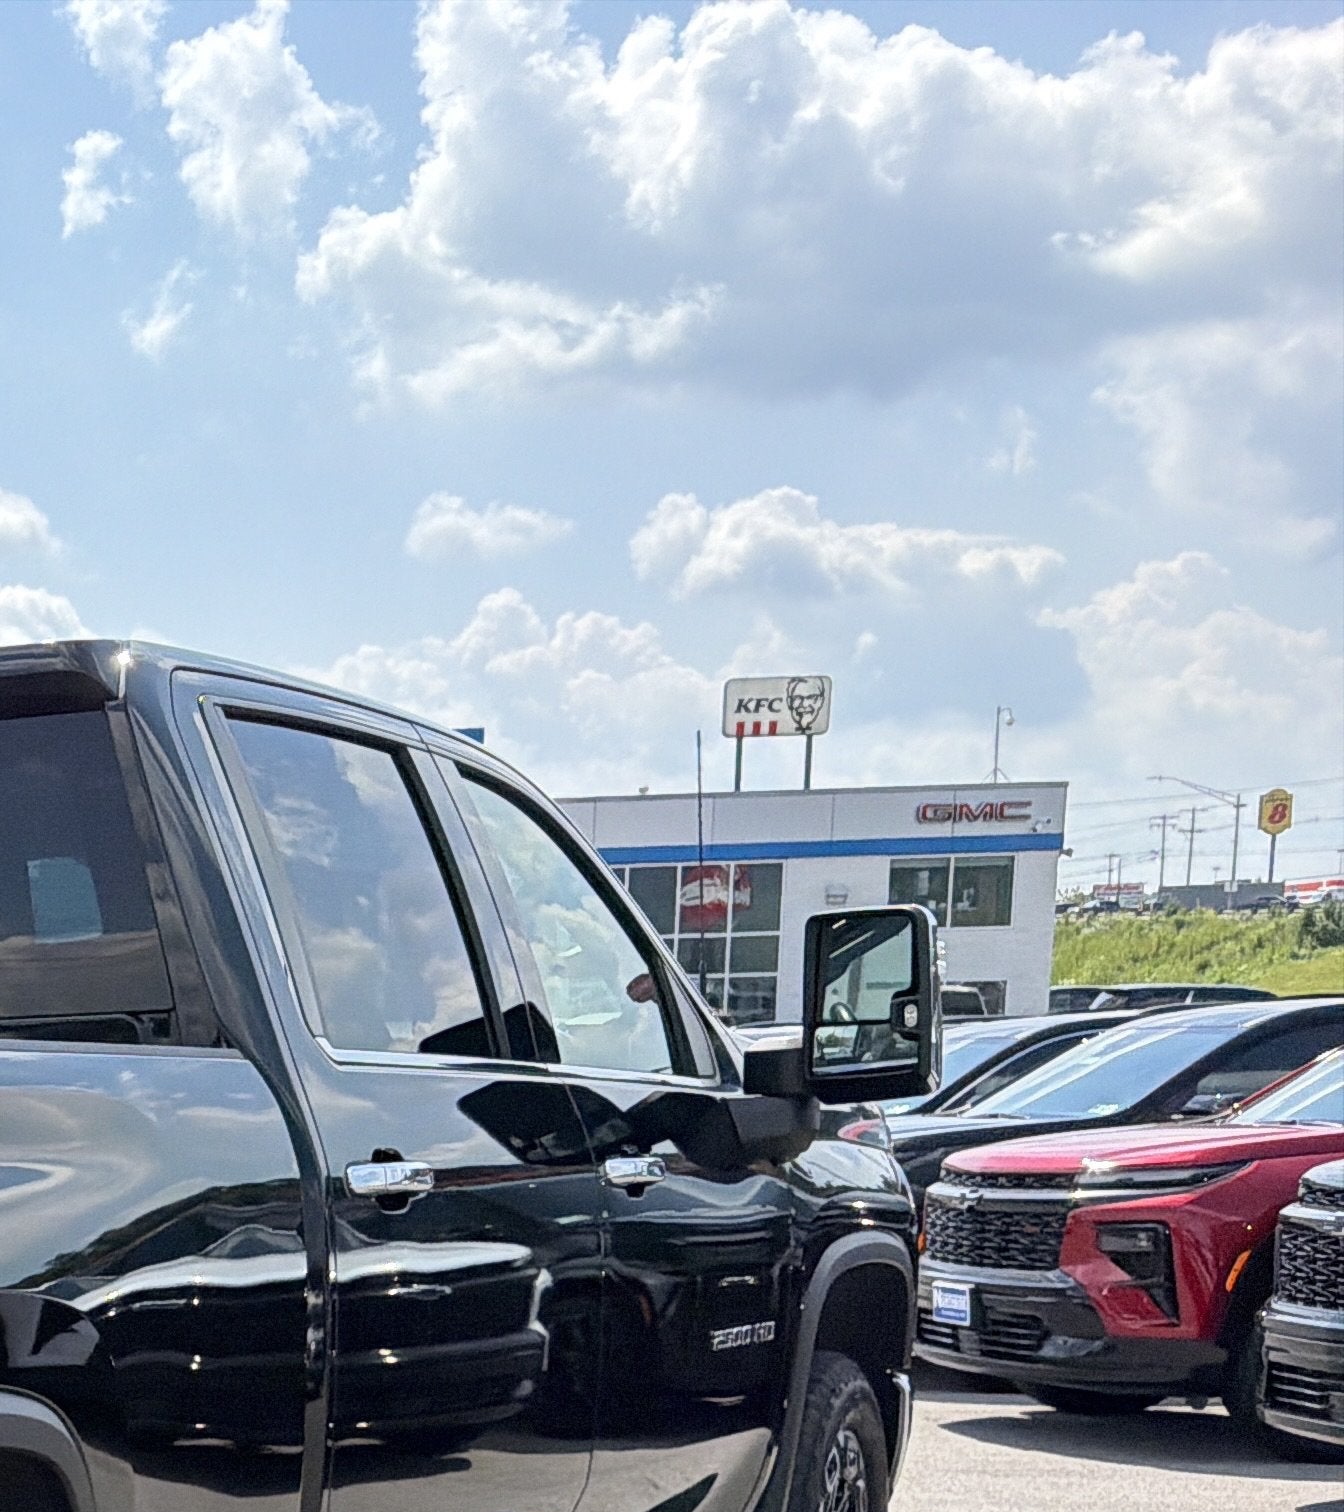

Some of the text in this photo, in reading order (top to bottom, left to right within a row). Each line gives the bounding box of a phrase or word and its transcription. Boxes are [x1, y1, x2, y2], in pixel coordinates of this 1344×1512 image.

[734, 697, 783, 713] KFC
[918, 800, 1032, 823] GMC
[1267, 803, 1288, 824] 8
